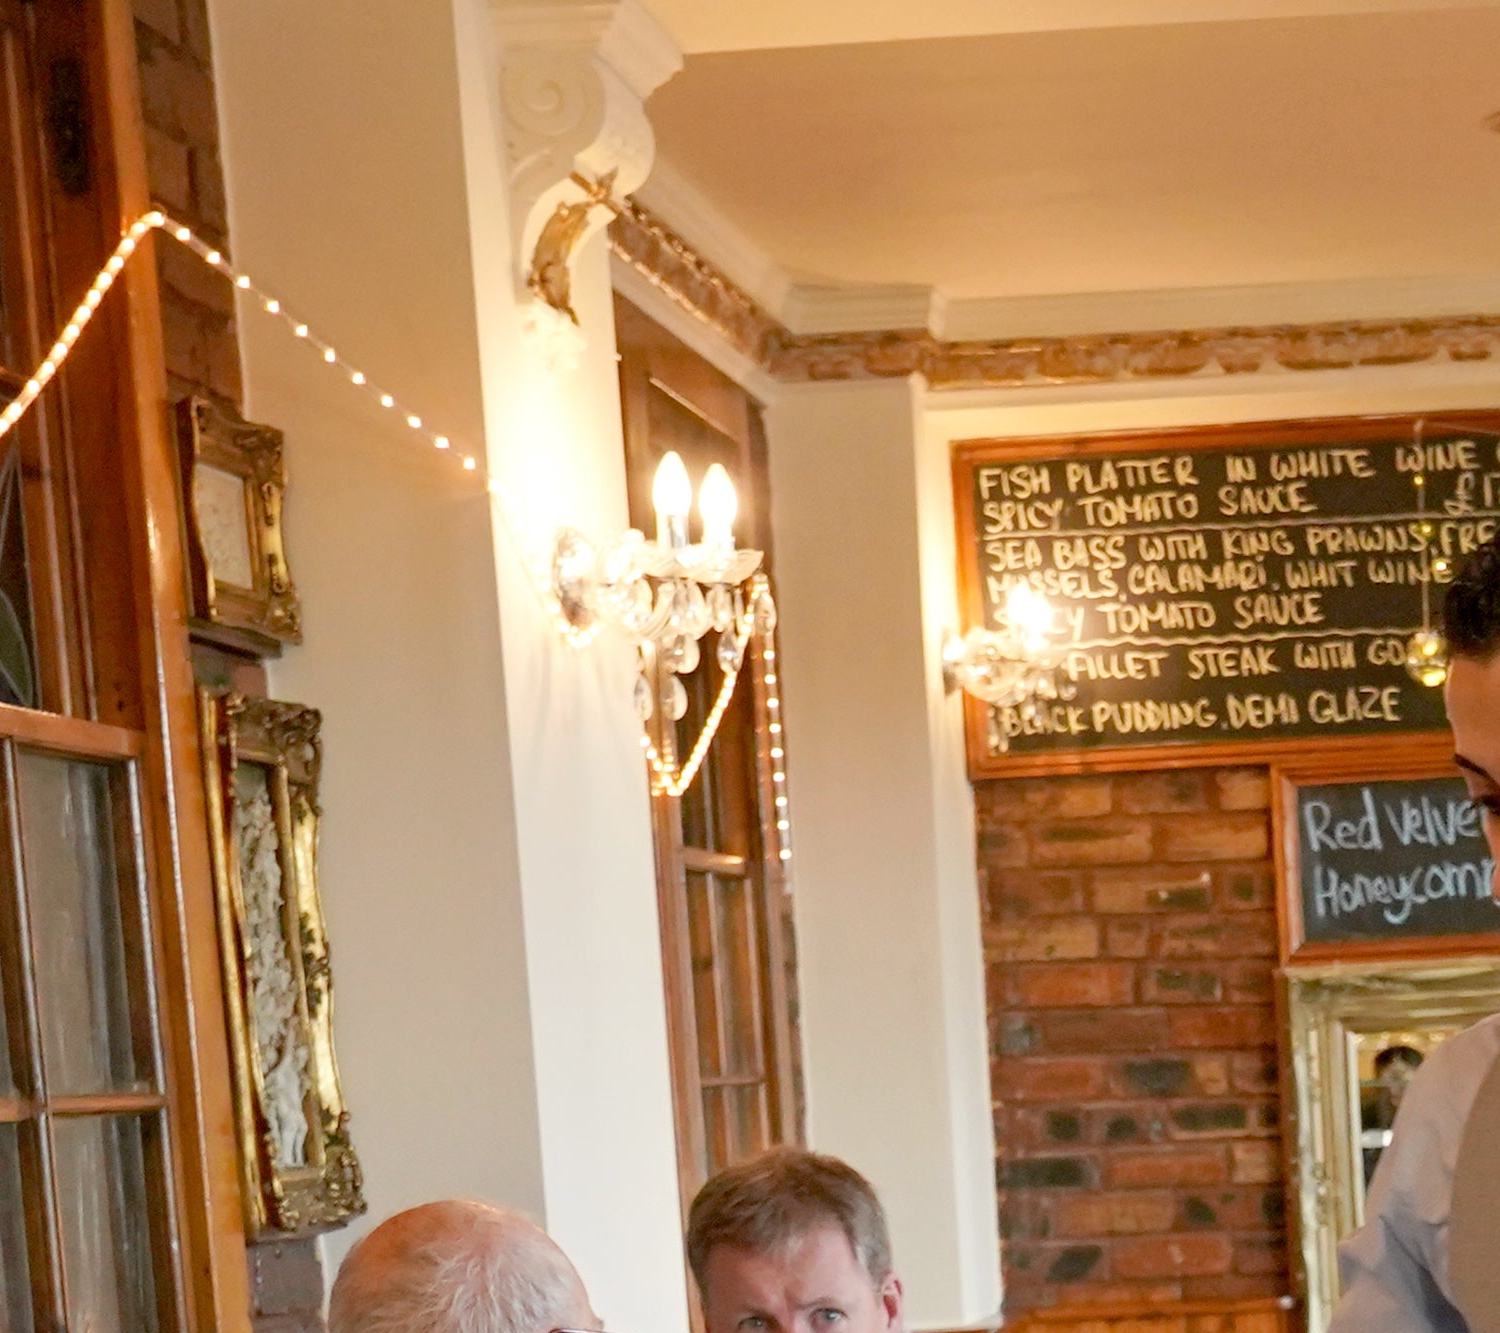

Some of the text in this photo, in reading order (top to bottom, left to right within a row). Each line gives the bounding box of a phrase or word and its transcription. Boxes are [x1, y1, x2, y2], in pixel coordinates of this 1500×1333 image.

[978, 466, 1050, 499] FISH
[1065, 456, 1199, 494] PLATTER
[1226, 456, 1257, 483] IN
[1270, 449, 1377, 481] WHITE
[1395, 440, 1481, 472] WINE
[982, 498, 1063, 533] SPICY
[1077, 491, 1199, 527] TOMATO
[1217, 481, 1318, 516] SAUCE
[986, 539, 1042, 571] SEA
[1052, 535, 1127, 571] BASS
[1138, 532, 1208, 562] WITH
[1221, 529, 1294, 558] KING
[1284, 560, 1357, 589] WHIT
[1368, 556, 1453, 585] WINE
[1096, 601, 1217, 634] TOMATO
[1234, 592, 1325, 630] SAUCE
[1065, 651, 1170, 682] FILLET
[1187, 645, 1281, 680] STEAK
[1293, 641, 1357, 670] WITH
[1309, 686, 1401, 724] GLAZE
[1304, 787, 1383, 852] Red
[1384, 796, 1488, 846] Velve
